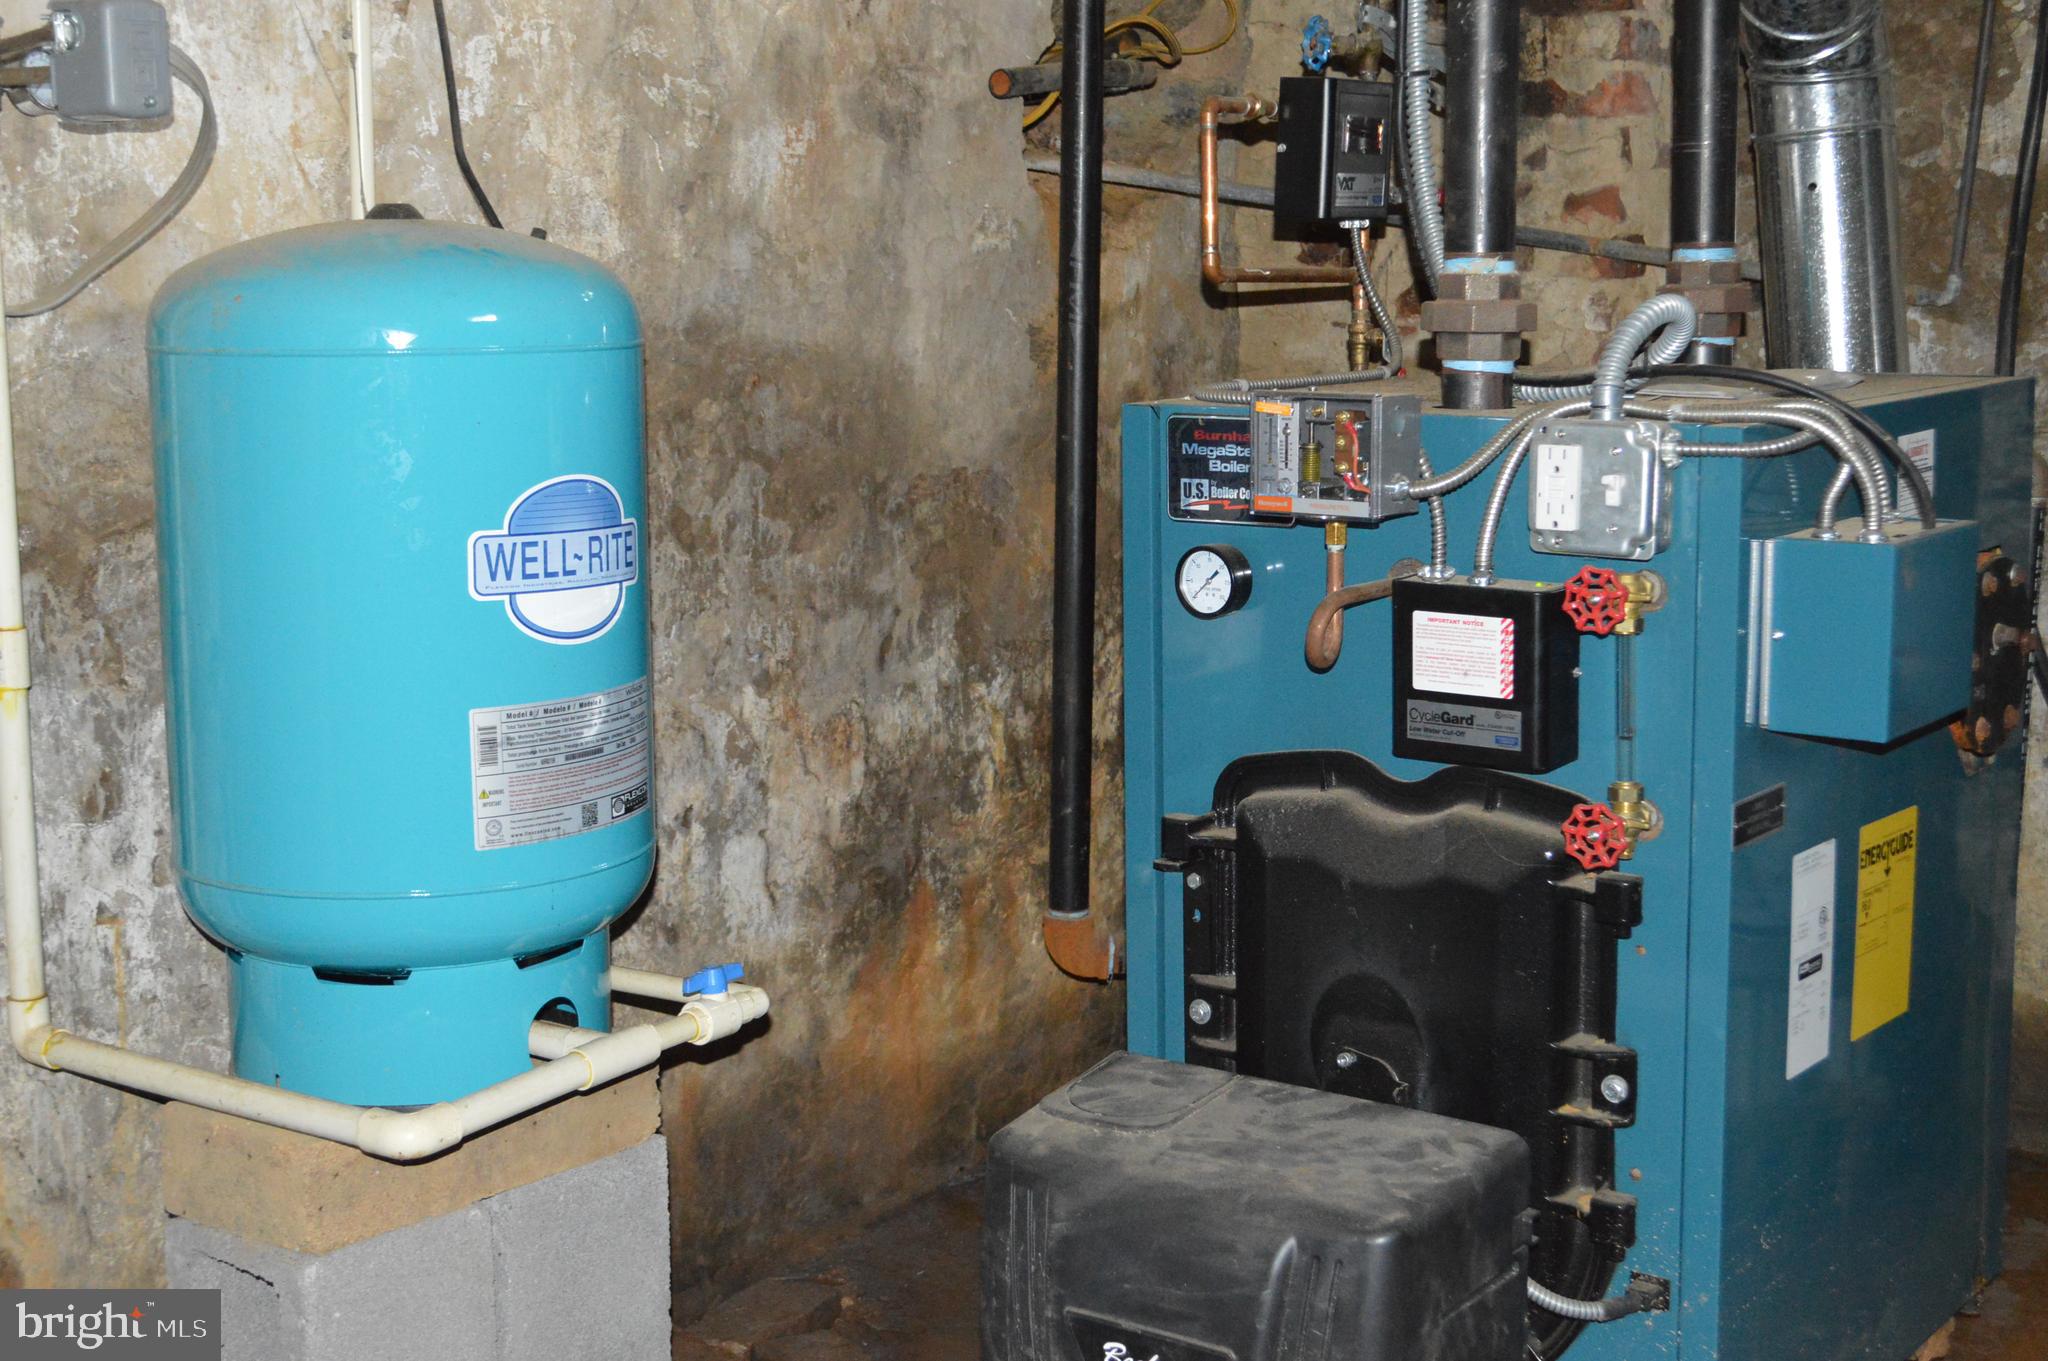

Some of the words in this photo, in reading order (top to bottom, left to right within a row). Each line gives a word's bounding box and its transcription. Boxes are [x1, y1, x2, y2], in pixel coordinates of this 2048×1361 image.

[1209, 460, 1251, 472] Boiler
[1183, 482, 1207, 499] U.S.
[1211, 486, 1238, 499] Boiler
[1427, 617, 1460, 625] IMPORTANT
[1463, 619, 1484, 627] NOTICE
[506, 711, 527, 719] Model
[1409, 707, 1474, 726] CycleGard
